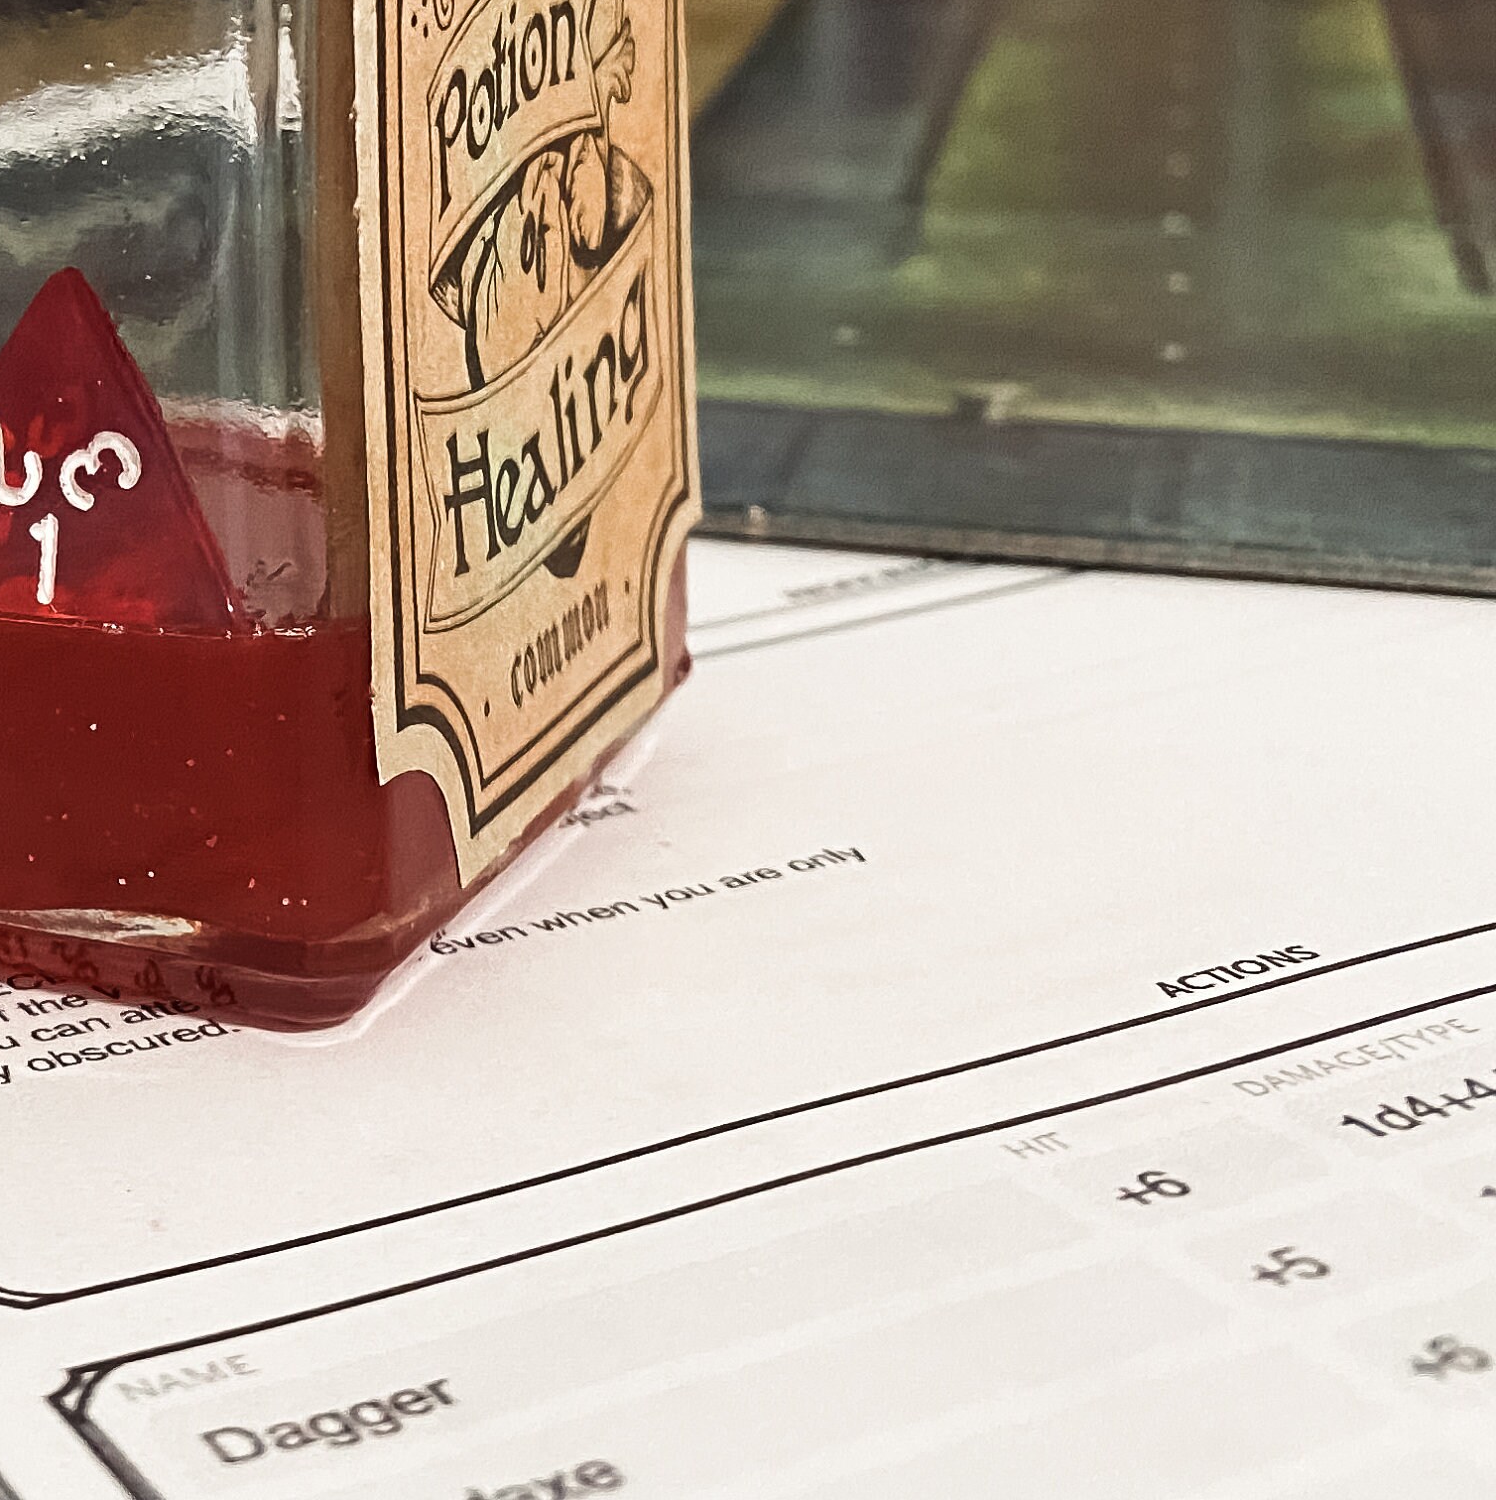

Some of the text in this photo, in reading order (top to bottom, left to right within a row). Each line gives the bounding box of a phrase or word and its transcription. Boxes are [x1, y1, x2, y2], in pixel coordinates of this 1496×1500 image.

[434, 0, 576, 222] Potion
[520, 194, 551, 293] of
[58, 430, 142, 512] 3
[443, 268, 649, 577] Healing
[29, 513, 58, 605] 1
[510, 582, 611, 708] common
[430, 843, 869, 956] even when you are only
[17, 992, 89, 1017] the
[1156, 944, 1321, 999] ACTIONS
[27, 1017, 242, 1073] obscured.
[31, 1017, 111, 1043] can
[1004, 1018, 1481, 1160] HIT DAMAGE/TYPE
[202, 1376, 460, 1466] Dagger
[1117, 1170, 1191, 1205] +6
[116, 1355, 259, 1403] NAME
[462, 1245, 1332, 1500] axe +5
